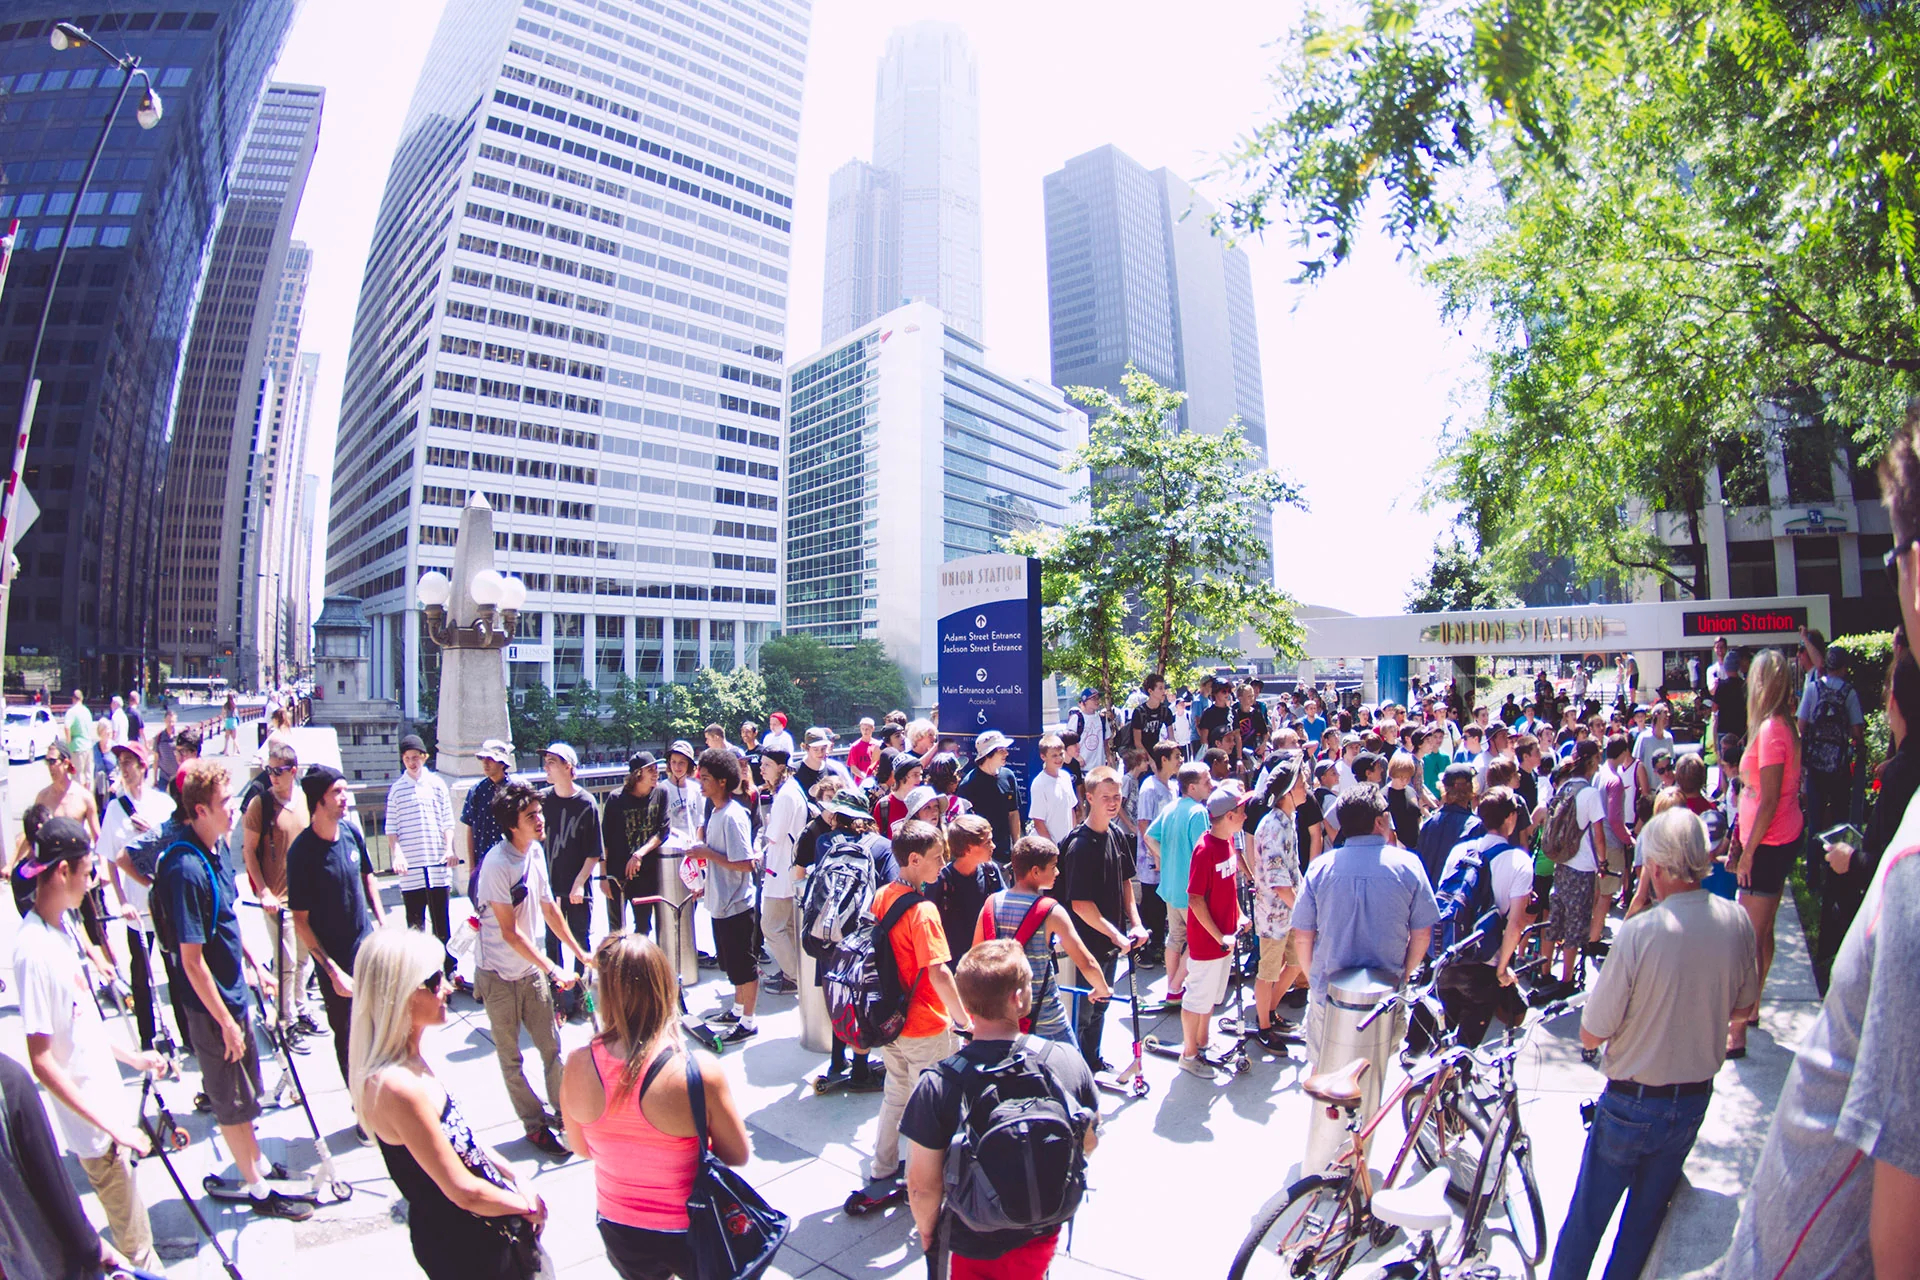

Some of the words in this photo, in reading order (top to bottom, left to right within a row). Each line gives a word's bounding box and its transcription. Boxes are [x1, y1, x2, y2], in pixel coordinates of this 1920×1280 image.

[942, 569, 974, 587] UNION
[978, 565, 1022, 584] STATION
[951, 586, 1010, 596] CHICAGO
[1697, 614, 1737, 633] Union
[1741, 612, 1794, 631] Station
[943, 633, 967, 642] Adams
[968, 631, 989, 641] Street
[991, 630, 1022, 640] Entrance
[1439, 618, 1506, 646] UNION
[1517, 615, 1605, 643] STATION
[942, 644, 968, 654] Jackson
[969, 643, 990, 653] Street
[992, 642, 1023, 652] Entrance
[942, 685, 958, 694] Main
[959, 684, 985, 695] Entrance
[995, 684, 1014, 694] Canal
[1014, 684, 1024, 695] St.
[968, 697, 997, 706] Accessible
